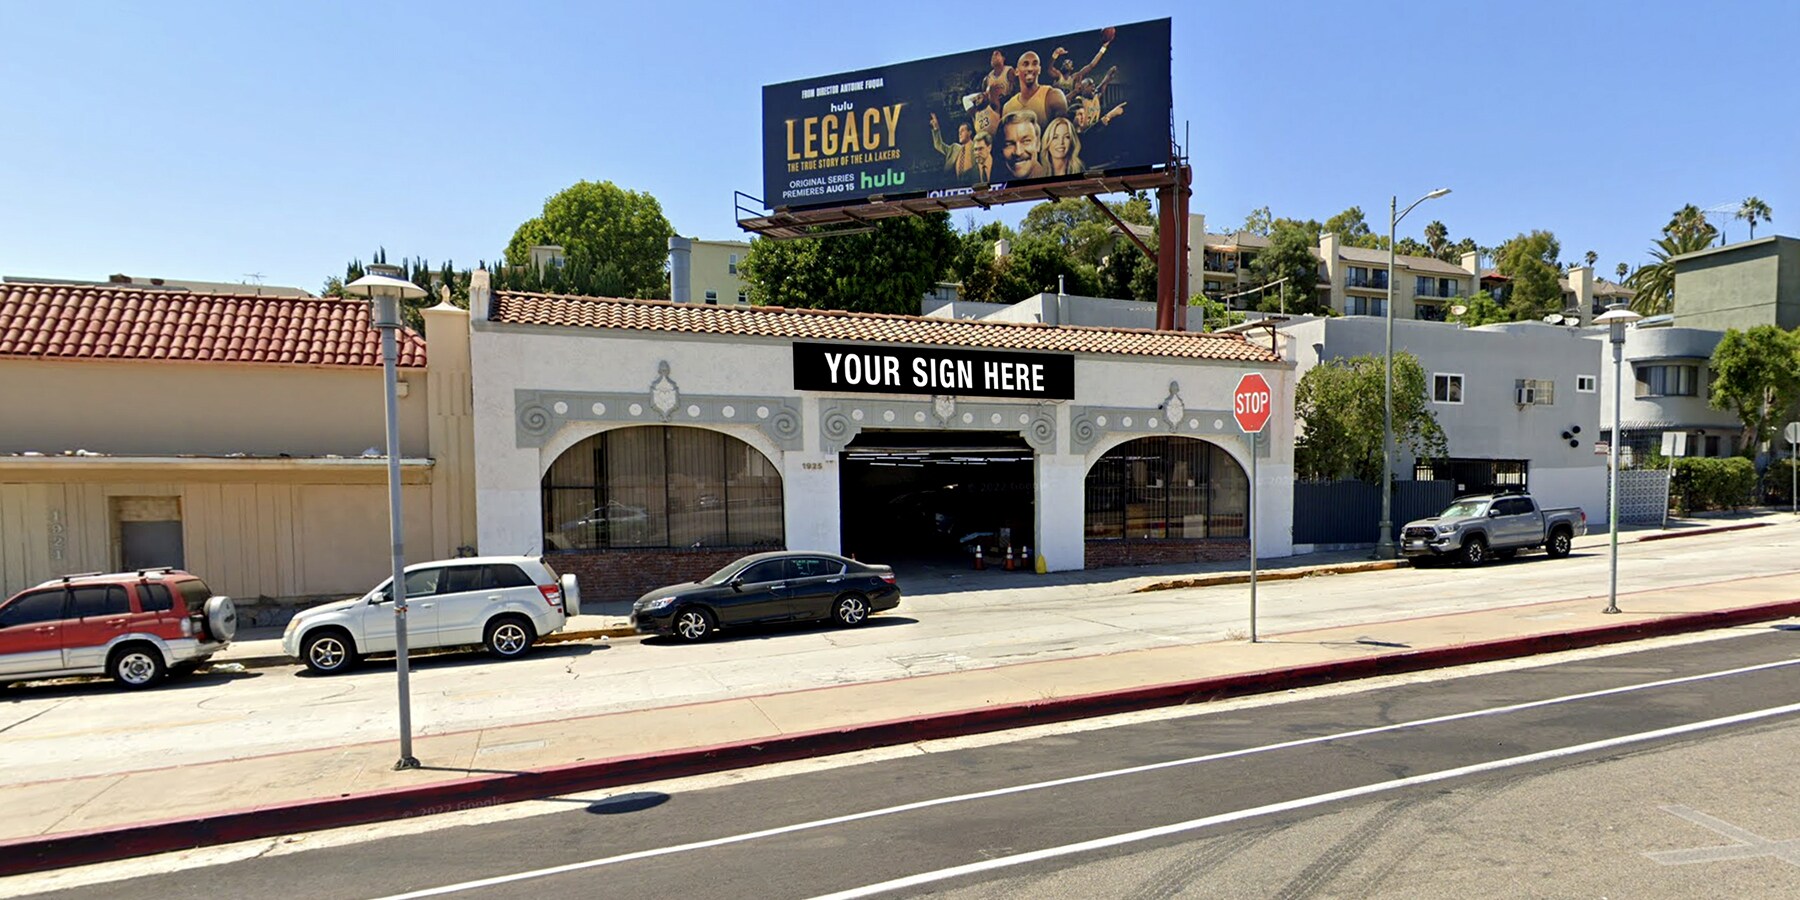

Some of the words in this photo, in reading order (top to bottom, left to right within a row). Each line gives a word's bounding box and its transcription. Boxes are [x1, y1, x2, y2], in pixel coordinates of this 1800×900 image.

[801, 88, 815, 99] FROM
[816, 84, 839, 97] DIRECTOR
[840, 80, 864, 93] ANTOINE
[830, 101, 854, 112] hulu
[785, 103, 903, 161] LEGACY
[979, 116, 990, 129] 23
[787, 162, 799, 172] THE
[801, 160, 817, 171] TRUE
[818, 157, 839, 169] STORY
[840, 156, 848, 167] OF
[850, 154, 863, 165] THE
[864, 153, 874, 163] LA
[874, 149, 901, 162] LAKERS
[789, 177, 826, 189] ORIGINAL
[827, 173, 855, 184] SERIES
[860, 168, 905, 189] hulu
[782, 185, 825, 199] PREMIERES
[826, 184, 844, 194] AUG
[845, 183, 855, 192] 15
[825, 352, 901, 387] YOUR
[912, 357, 973, 389] SIGN
[984, 361, 1045, 392] HERE
[1236, 391, 1269, 414] STOP
[802, 462, 823, 470] 1925
[51, 511, 63, 560] 1921
